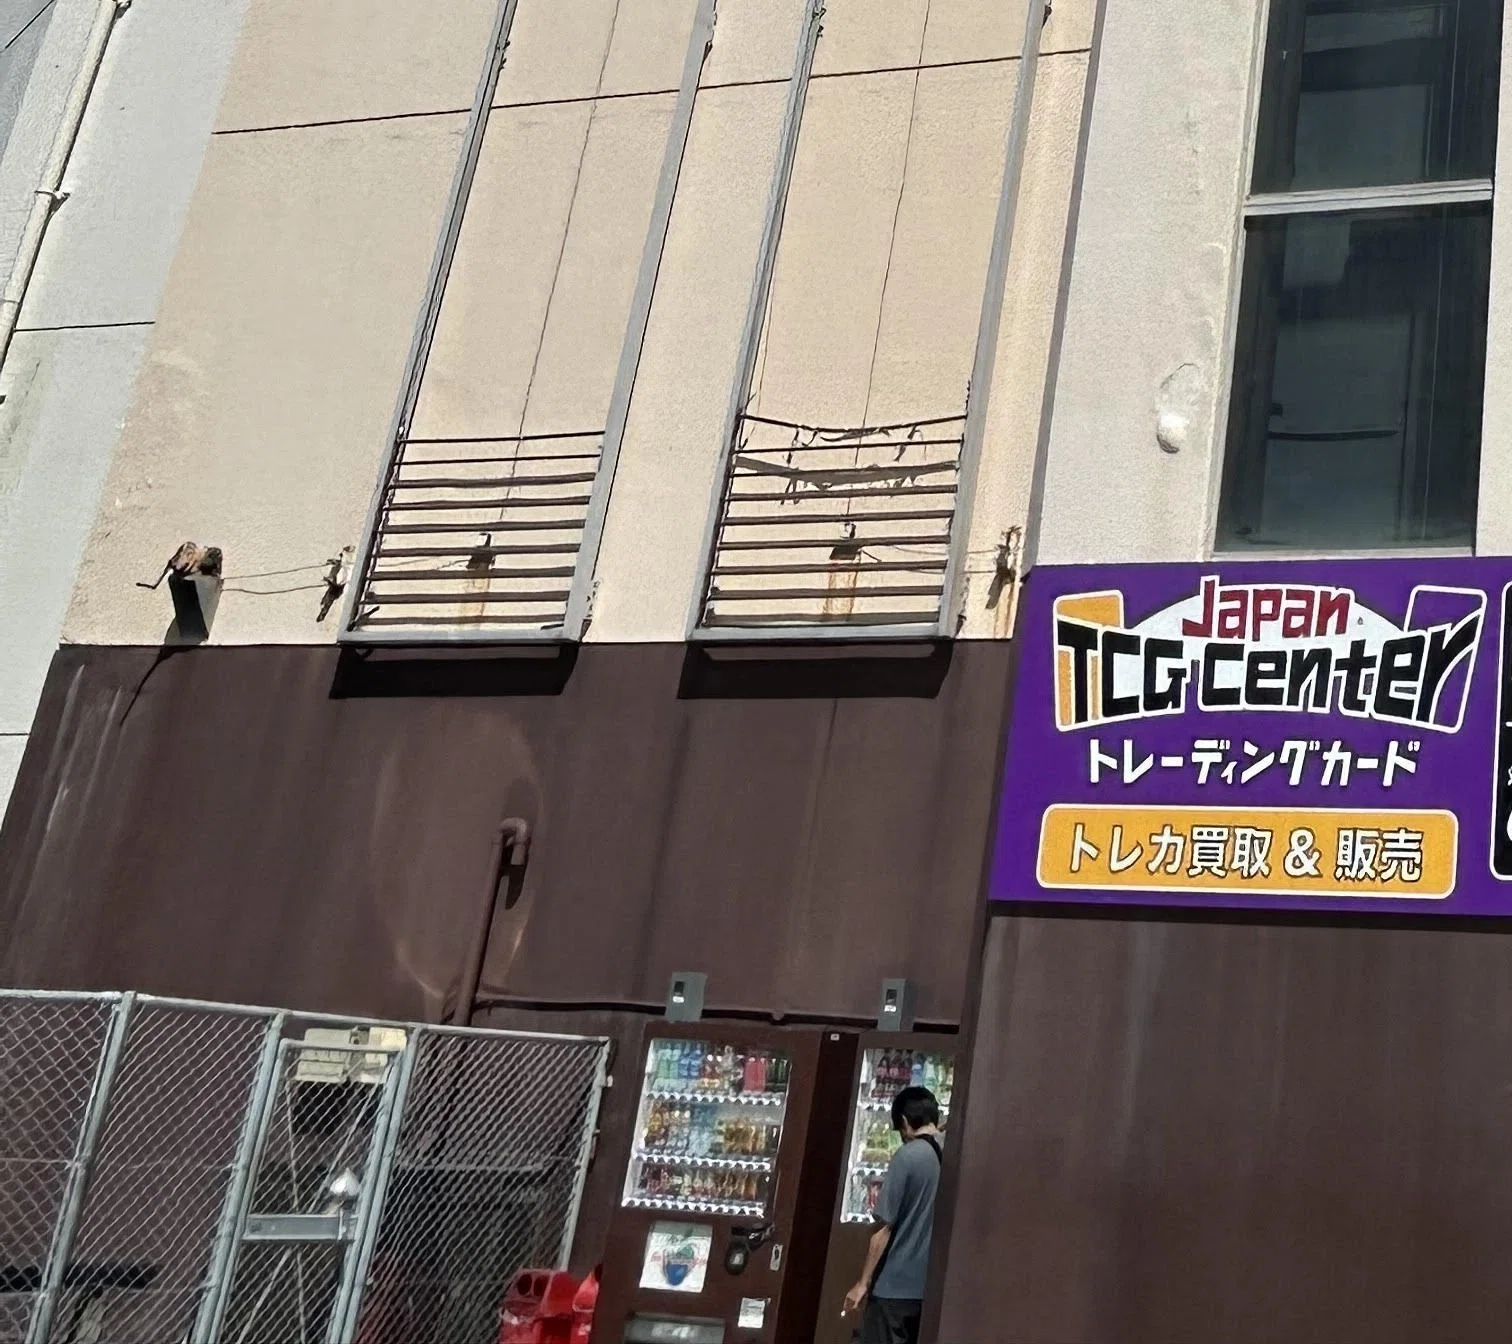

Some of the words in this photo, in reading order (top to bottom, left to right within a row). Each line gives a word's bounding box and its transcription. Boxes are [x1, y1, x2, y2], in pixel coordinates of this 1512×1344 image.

[1089, 738, 1421, 787] トレーディングカード
